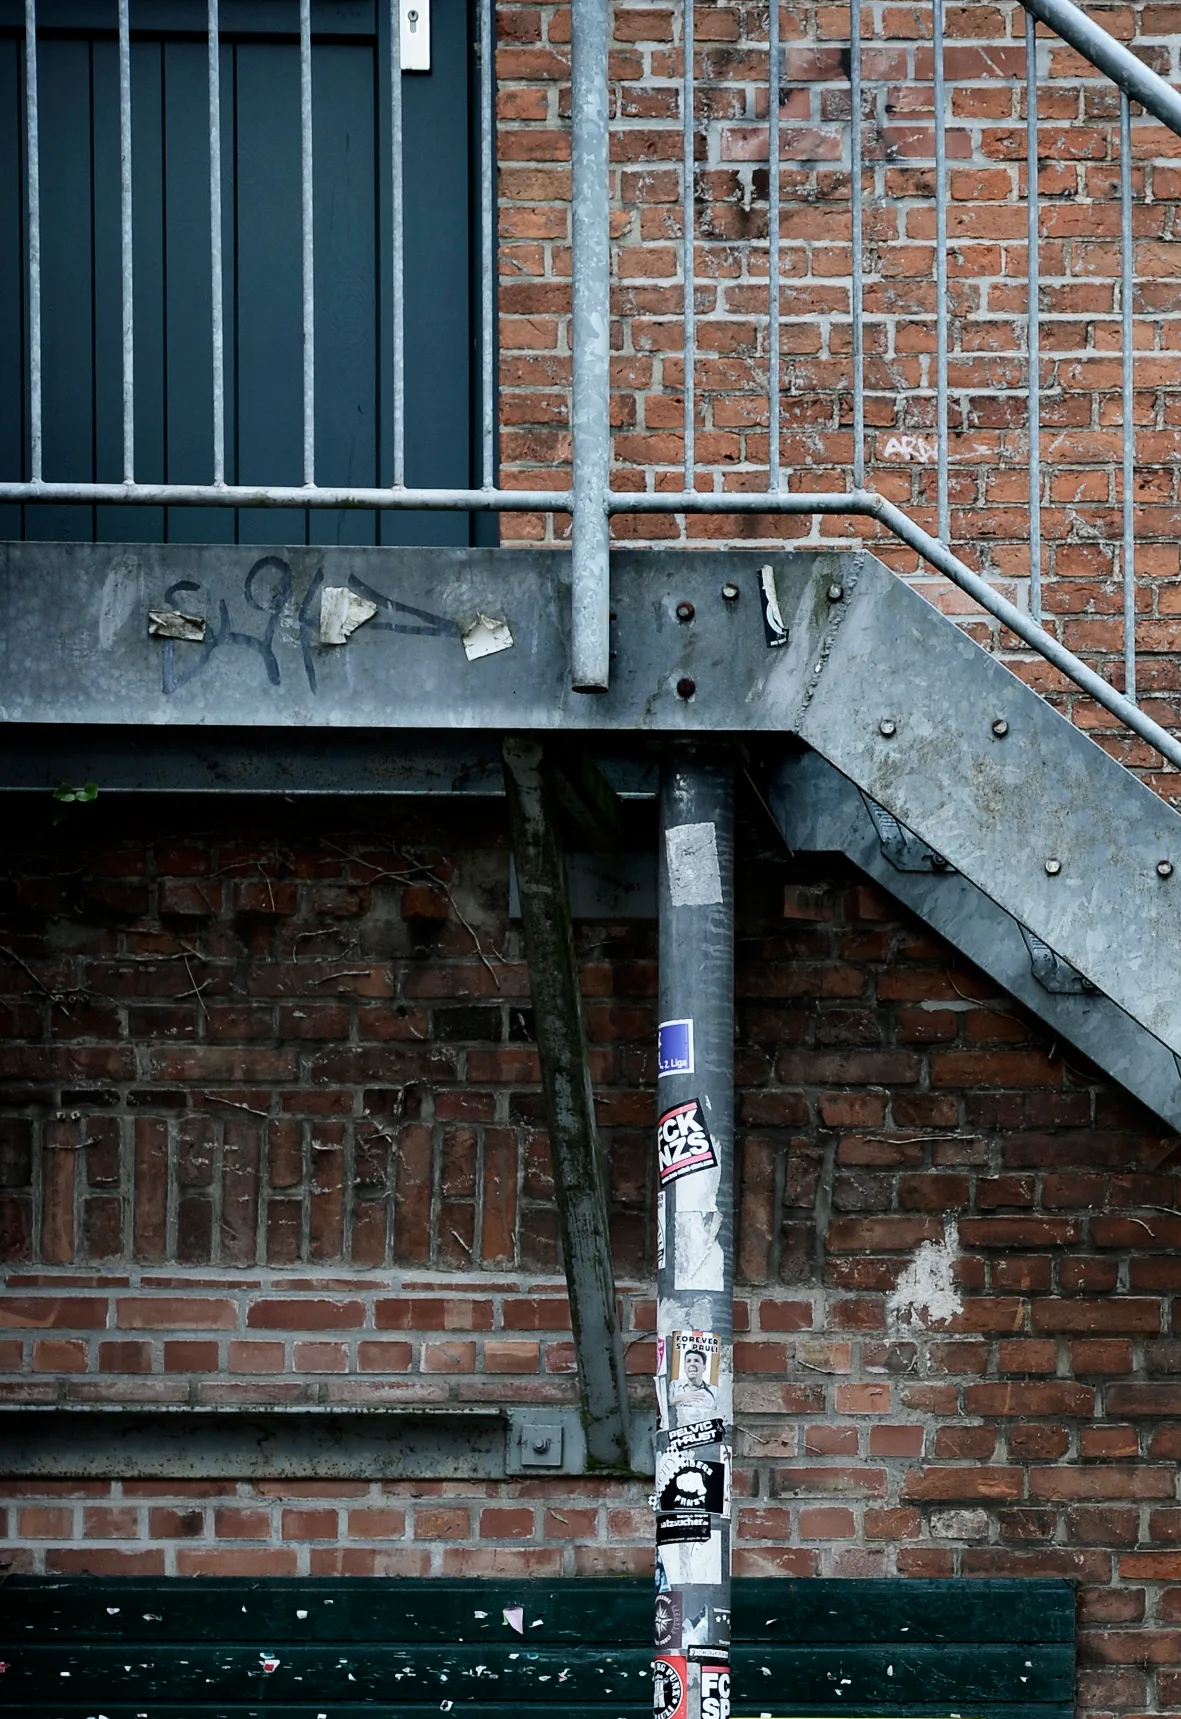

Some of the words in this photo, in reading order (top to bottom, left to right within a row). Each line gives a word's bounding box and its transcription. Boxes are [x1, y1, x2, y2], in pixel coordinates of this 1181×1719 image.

[658, 1131, 709, 1172] NZS
[676, 1335, 718, 1346] FOREVER
[692, 1343, 718, 1353] PAULI
[669, 1420, 713, 1440] PELVIC
[670, 1429, 717, 1449] THRUST
[701, 1672, 730, 1699] FC
